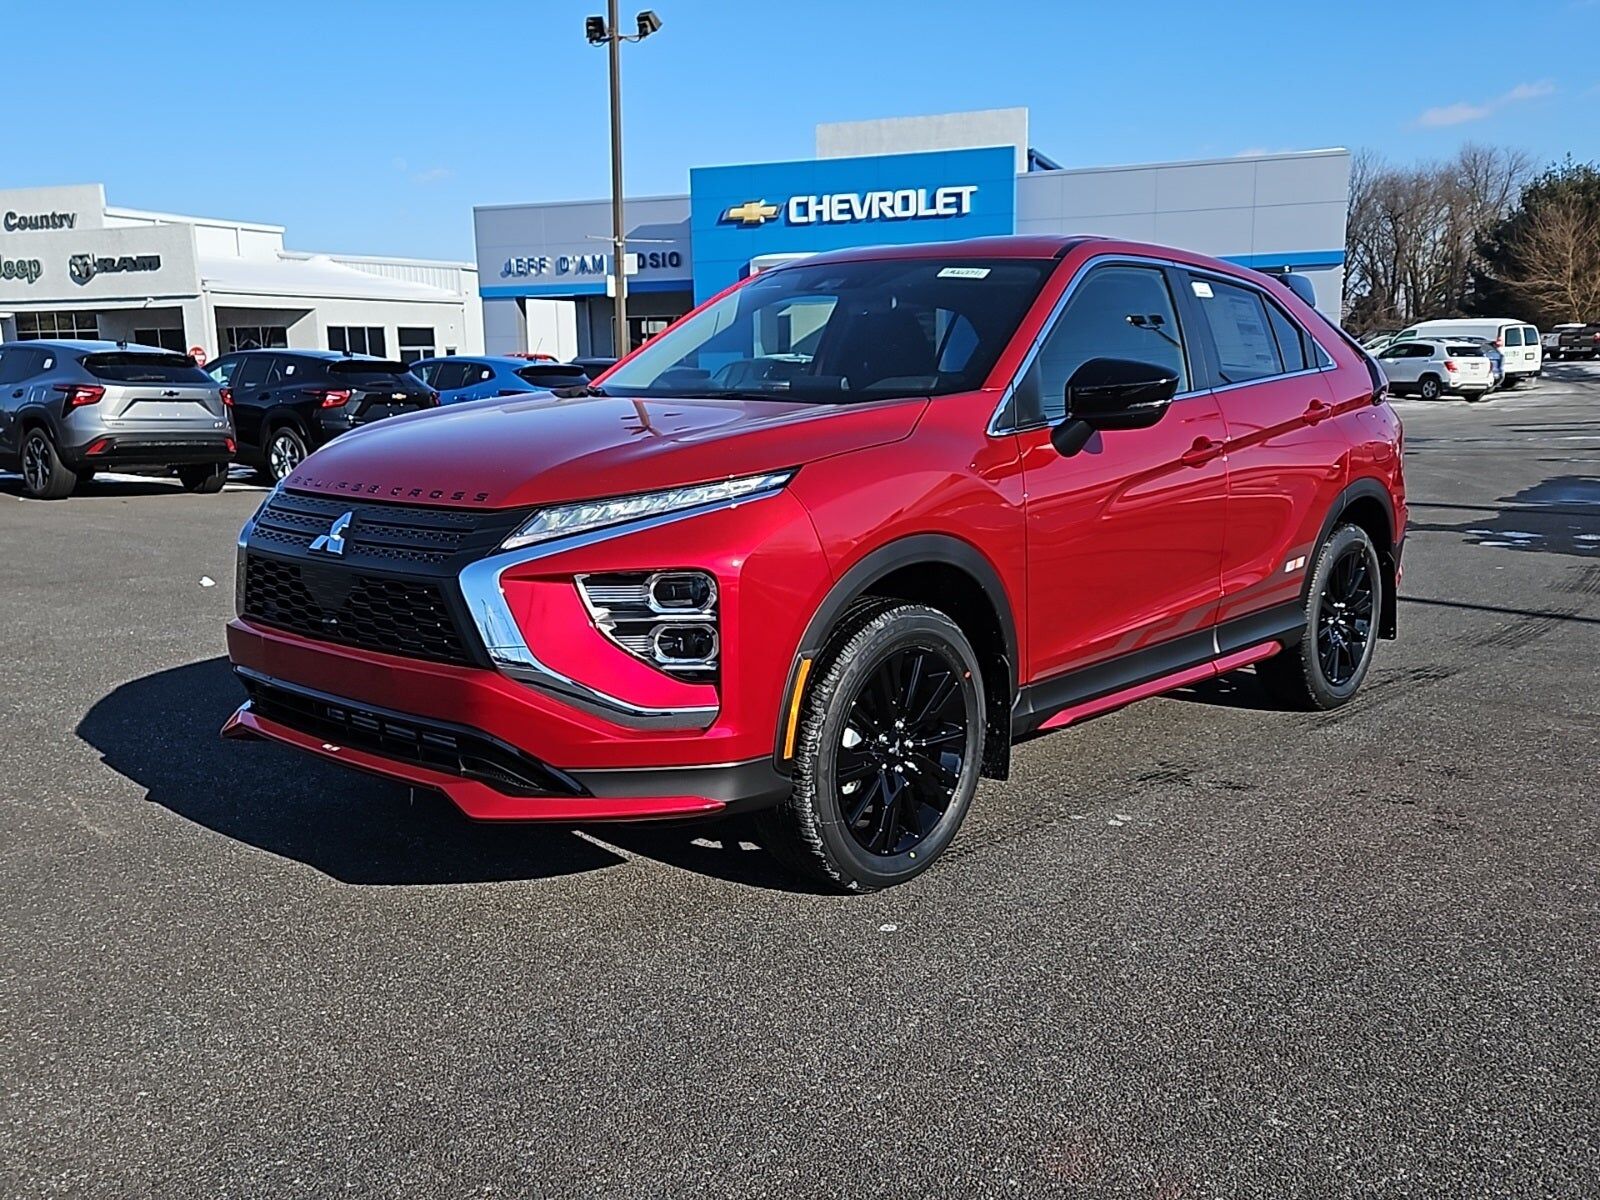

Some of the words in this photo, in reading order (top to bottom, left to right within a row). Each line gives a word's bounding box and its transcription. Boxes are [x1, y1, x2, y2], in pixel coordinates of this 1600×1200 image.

[787, 185, 979, 224] CHEVROLET
[4, 210, 77, 232] Country
[96, 254, 161, 274] RAM
[502, 256, 549, 275] JEFF
[558, 251, 682, 274] D'AMOSIO
[291, 476, 381, 494] ECLIPSE
[389, 486, 490, 502] CROSS
